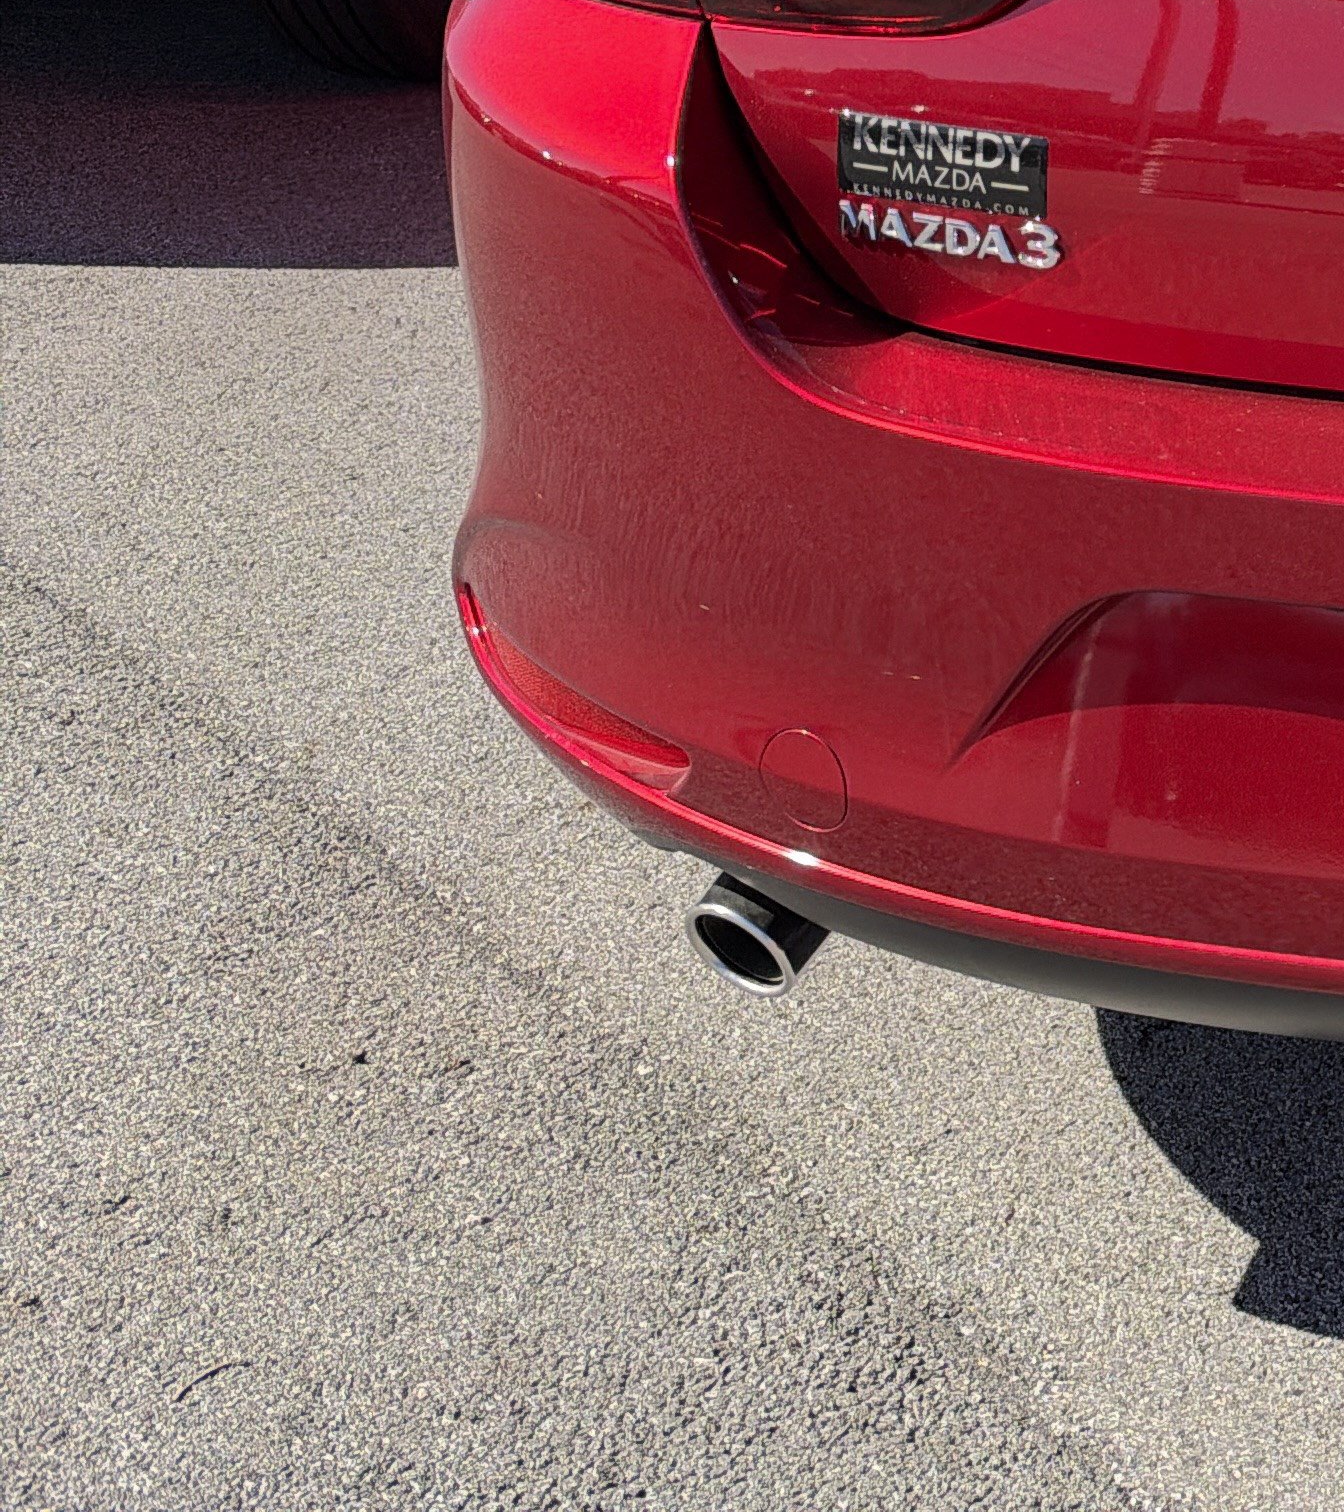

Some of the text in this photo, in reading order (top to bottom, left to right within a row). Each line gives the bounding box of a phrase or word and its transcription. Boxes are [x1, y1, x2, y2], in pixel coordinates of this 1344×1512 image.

[852, 114, 1031, 173] KENNEDY
[892, 159, 988, 194] MAZDA
[852, 182, 1030, 216] KENNEDYMAZDA.COM
